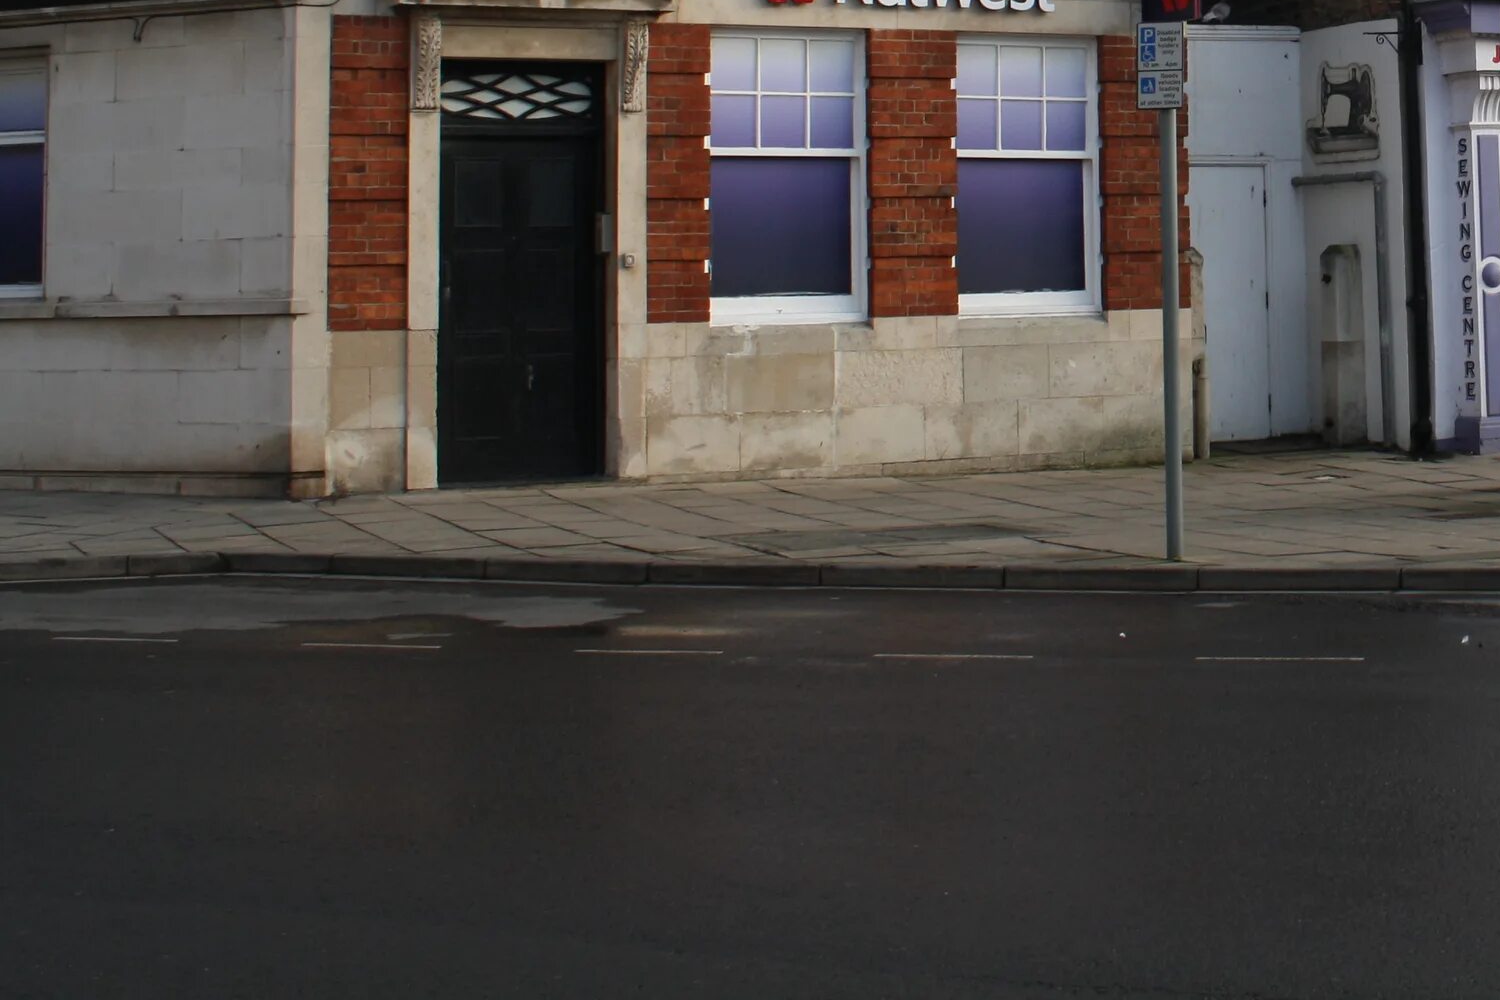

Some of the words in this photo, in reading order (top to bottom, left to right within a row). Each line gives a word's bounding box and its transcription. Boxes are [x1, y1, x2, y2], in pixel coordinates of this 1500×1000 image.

[1144, 29, 1154, 43] P
[1456, 138, 1471, 262] SEWING
[1461, 275, 1476, 401] CENTRE
